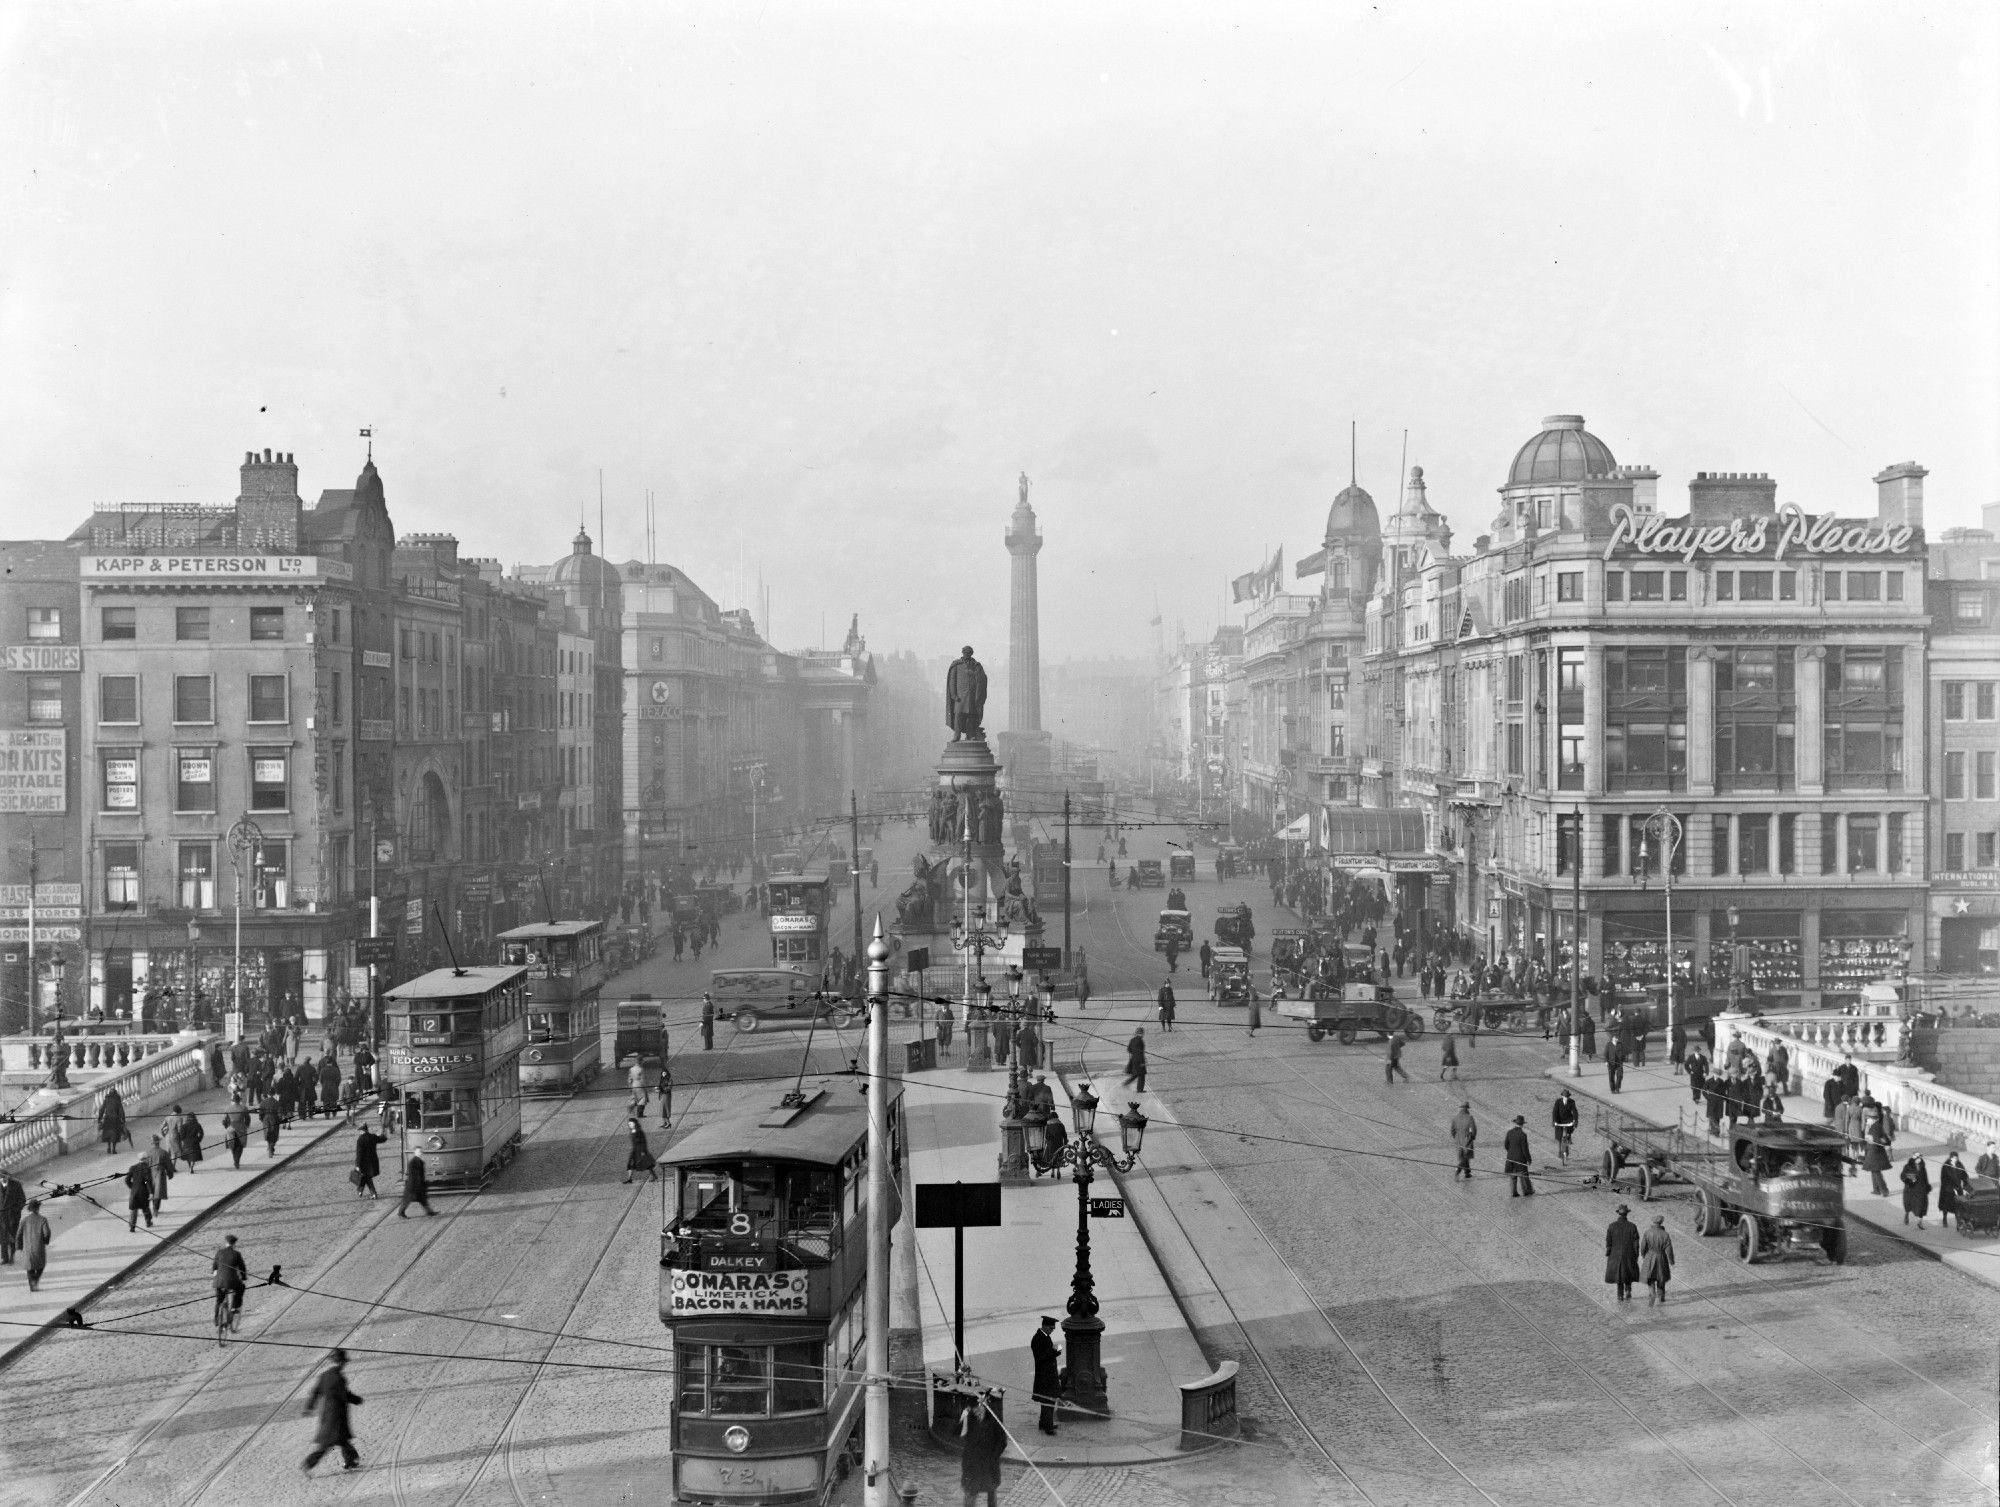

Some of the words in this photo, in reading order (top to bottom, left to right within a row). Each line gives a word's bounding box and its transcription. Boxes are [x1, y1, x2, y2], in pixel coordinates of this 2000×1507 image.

[1602, 502, 1769, 563] Player's
[1775, 501, 1914, 561] Please
[96, 558, 144, 572] KAPP
[149, 558, 162, 572] &
[168, 558, 267, 572] PETERSON
[23, 648, 78, 668] STORES
[641, 706, 681, 719] TEXACO
[9, 732, 50, 746] AGENTS
[23, 749, 62, 771] KITS
[20, 795, 62, 809] MAGNET
[526, 953, 536, 964] 9
[423, 1019, 435, 1032] 12
[392, 1054, 473, 1064] TEDCASTLE'S
[414, 1065, 449, 1073] COAL
[1093, 1200, 1122, 1209] LADIES
[730, 1213, 751, 1235] 8
[710, 1256, 764, 1267] DALKEY
[686, 1273, 790, 1290] O'MARA'S
[694, 1290, 780, 1299] LIMERICK
[675, 1296, 736, 1310] BACON
[739, 1301, 749, 1310] &
[753, 1297, 804, 1310] HAMS
[719, 1467, 756, 1485] 72
